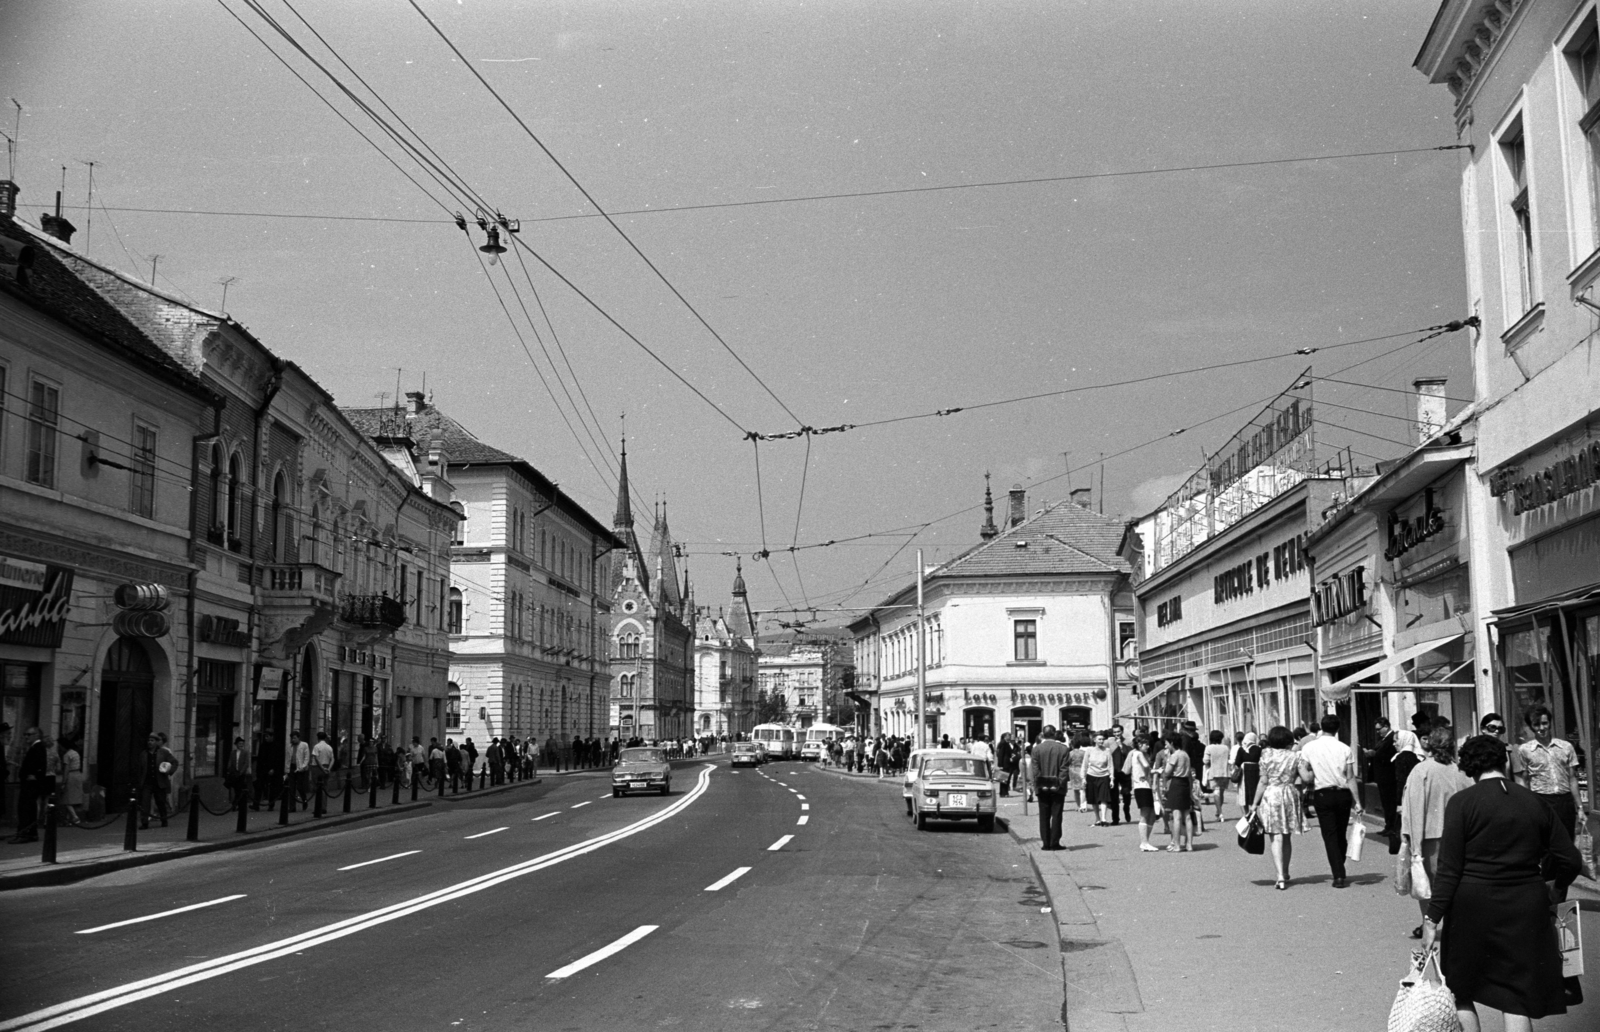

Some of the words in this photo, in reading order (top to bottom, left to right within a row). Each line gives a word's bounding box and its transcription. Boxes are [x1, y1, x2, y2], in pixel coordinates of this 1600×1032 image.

[1214, 559, 1253, 604] ARTICOLE
[1256, 552, 1270, 588] DE
[796, 633, 835, 641] METROPOL
